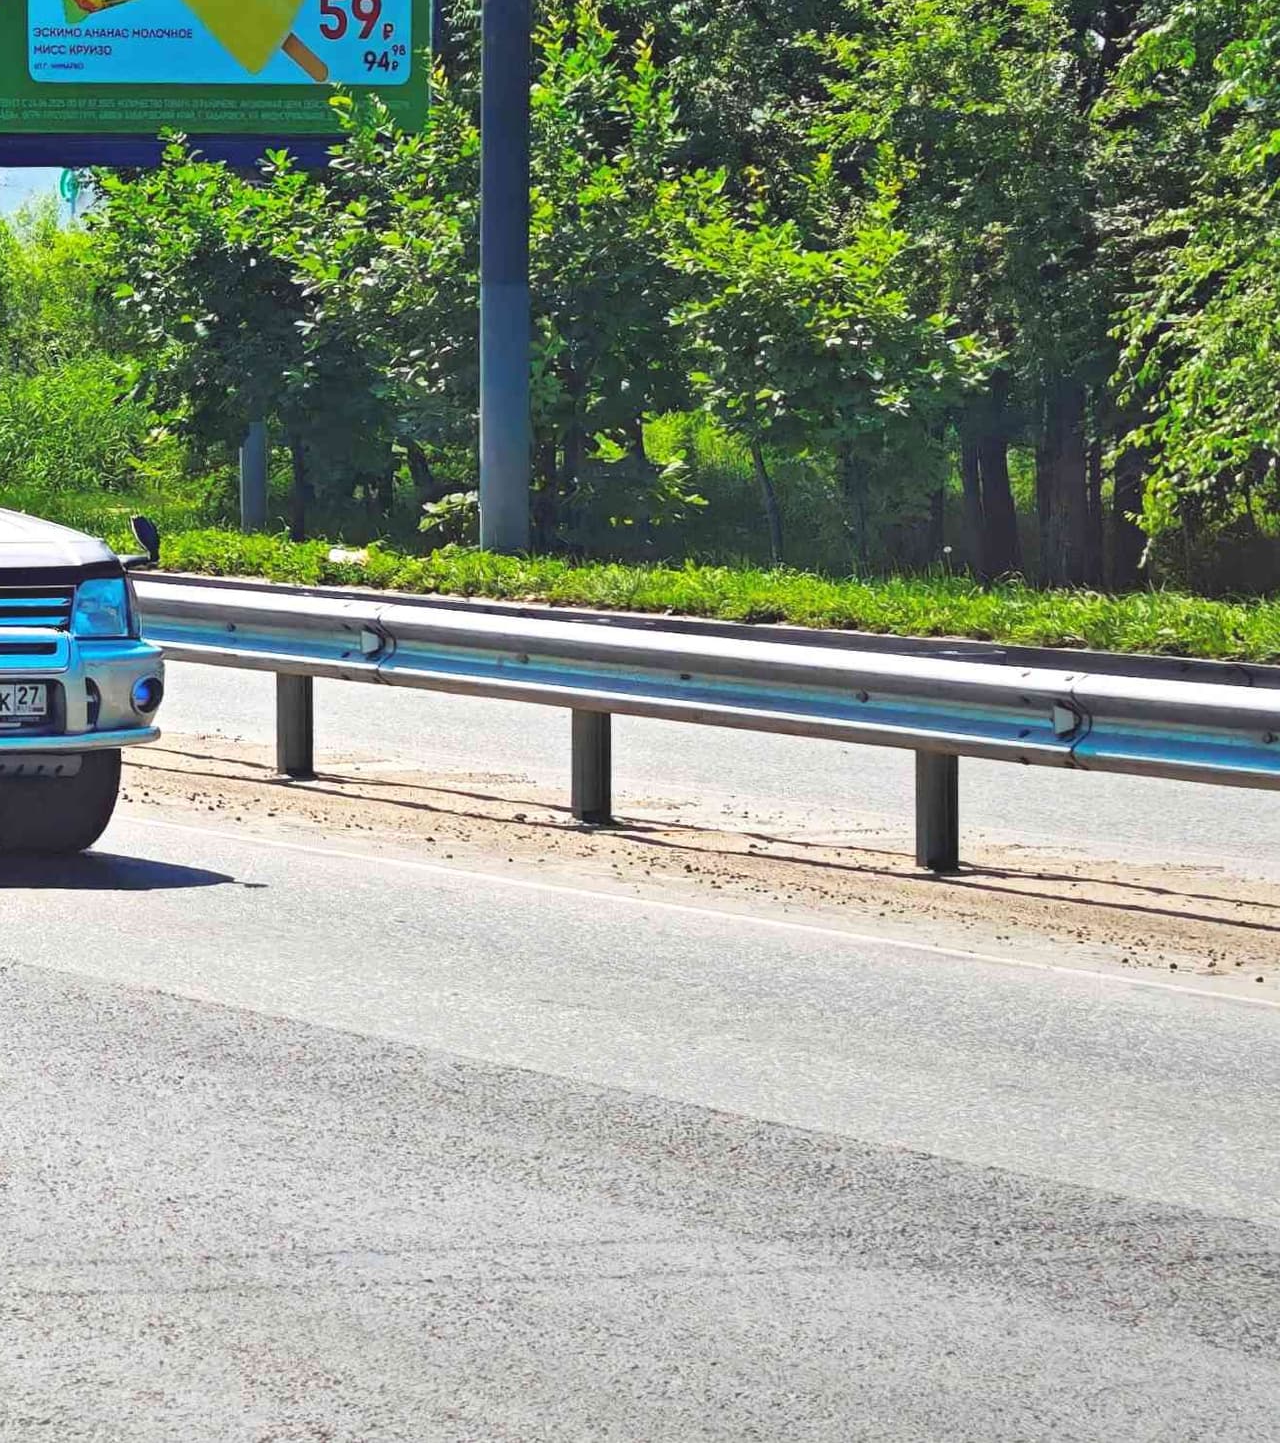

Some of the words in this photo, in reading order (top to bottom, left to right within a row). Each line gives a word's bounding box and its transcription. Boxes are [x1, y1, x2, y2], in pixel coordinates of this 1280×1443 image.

[32, 27, 83, 38] ЭСКИМО
[84, 27, 130, 39] АНАНАС
[131, 28, 193, 40] МОЛОЧНОЕ
[33, 44, 67, 56] МИСС
[362, 50, 390, 73] 94
[17, 686, 39, 706] 27
